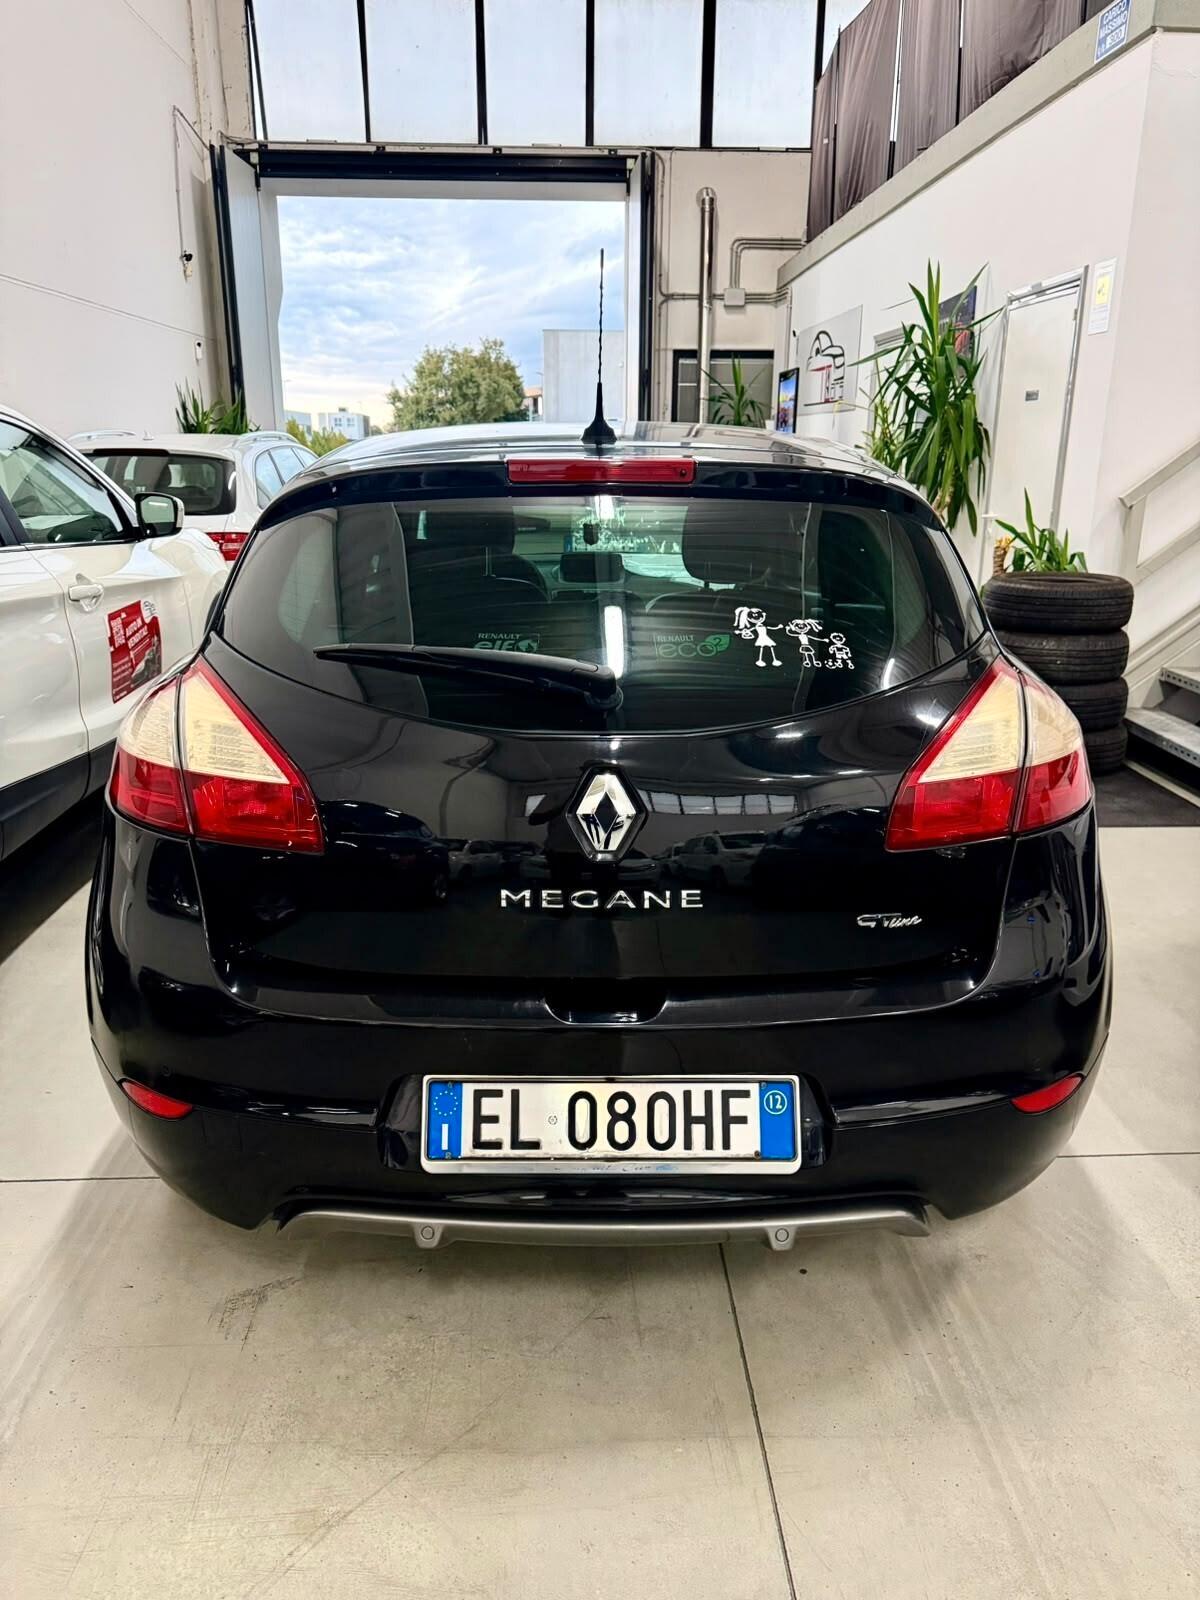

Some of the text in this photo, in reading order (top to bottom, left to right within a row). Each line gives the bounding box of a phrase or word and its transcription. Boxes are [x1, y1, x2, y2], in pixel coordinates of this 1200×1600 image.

[657, 634, 694, 642] RENAULT
[473, 641, 515, 652] elf
[500, 889, 704, 909] MEGANE
[769, 1094, 783, 1109] 12
[472, 1089, 751, 1152] EL 080HF
